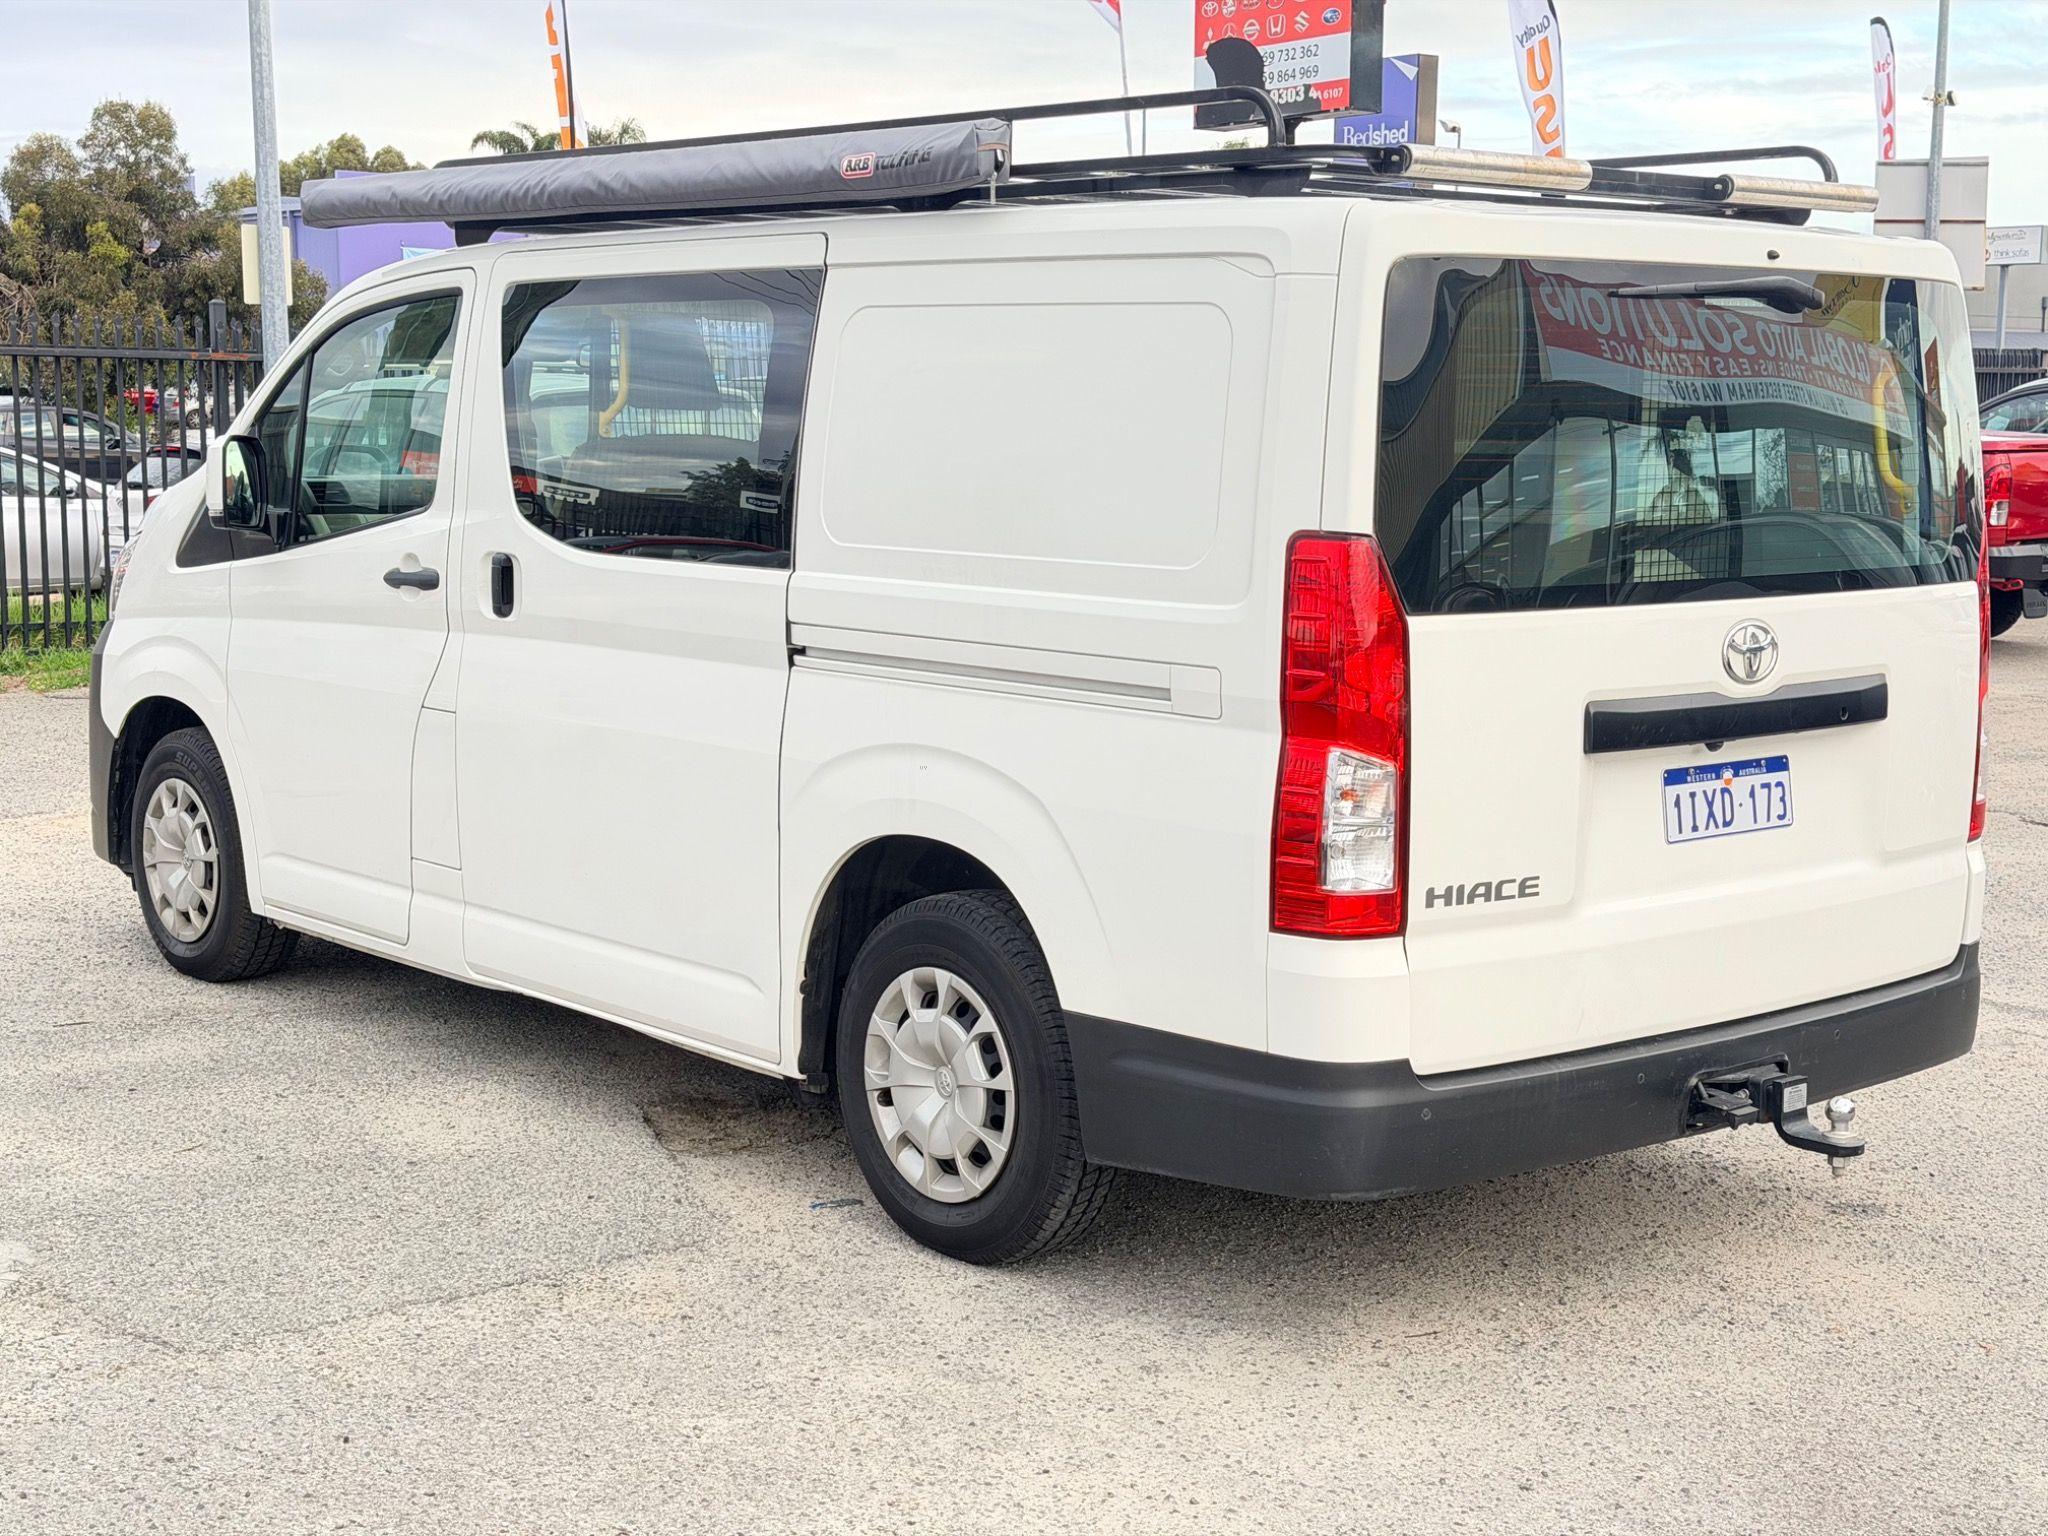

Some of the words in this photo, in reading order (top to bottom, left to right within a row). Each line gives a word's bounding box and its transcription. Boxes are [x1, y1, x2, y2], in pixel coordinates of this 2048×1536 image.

[1277, 47, 1297, 62] 732
[1300, 44, 1320, 59] 362
[1277, 68, 1297, 83] 864
[1299, 65, 1320, 80] 969
[1323, 87, 1344, 99] 6107
[1343, 120, 1409, 146] Bedshed
[845, 157, 870, 172] ARB
[1686, 772, 1716, 783] WESTERN
[1738, 766, 1767, 777] AUSTRALIA
[1425, 875, 1540, 909] HIACE
